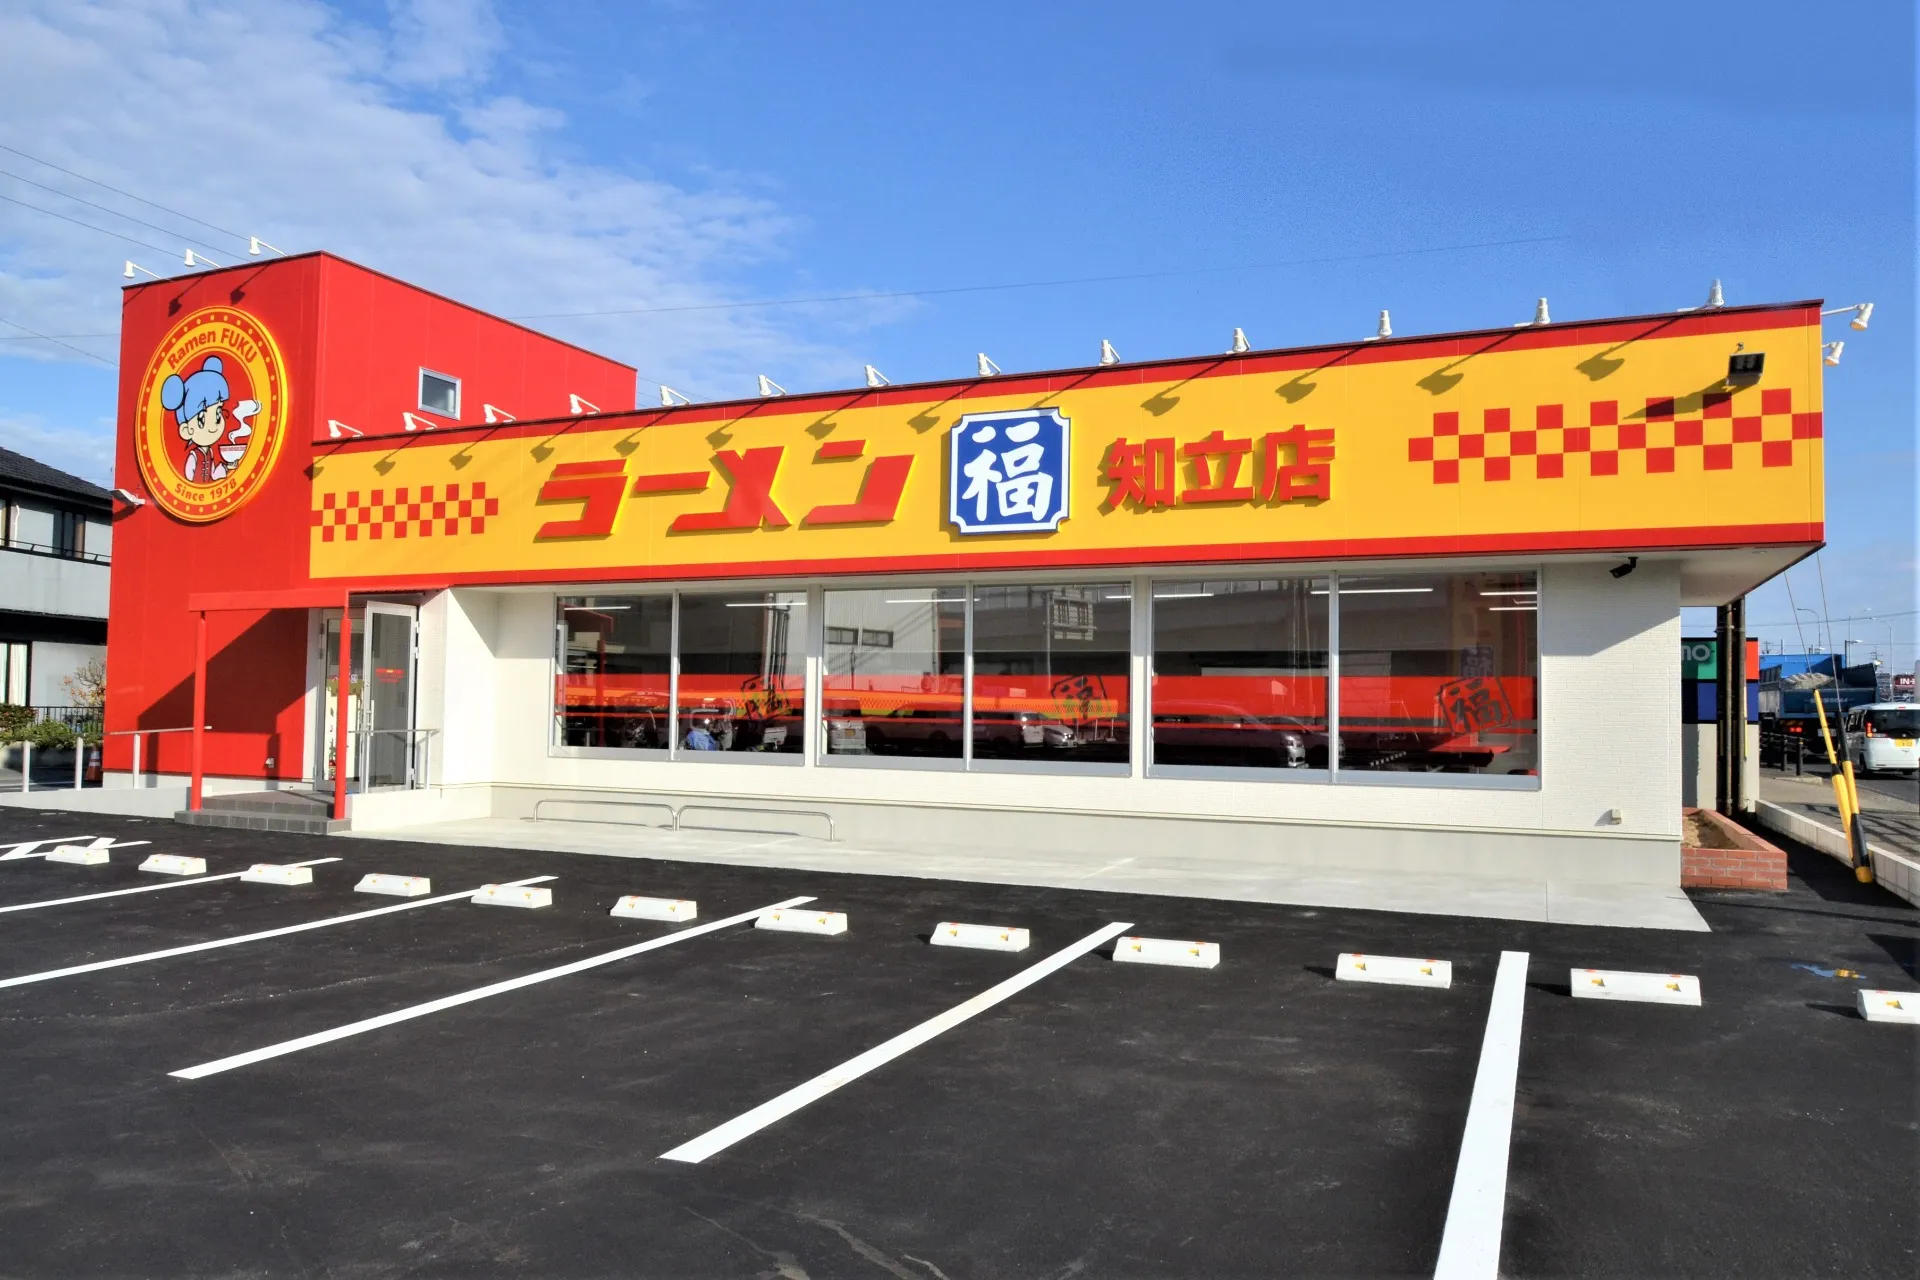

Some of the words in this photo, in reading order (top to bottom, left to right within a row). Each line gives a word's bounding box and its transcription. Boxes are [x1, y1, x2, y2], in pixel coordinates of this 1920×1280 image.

[167, 330, 216, 370] Ramen
[220, 327, 257, 363] FUKU
[174, 483, 205, 501] Since
[210, 478, 237, 500] 1978
[536, 439, 919, 540] ラーメン
[961, 421, 1054, 522] 福
[1108, 424, 1336, 507] 知立店
[1450, 678, 1502, 733] 福
